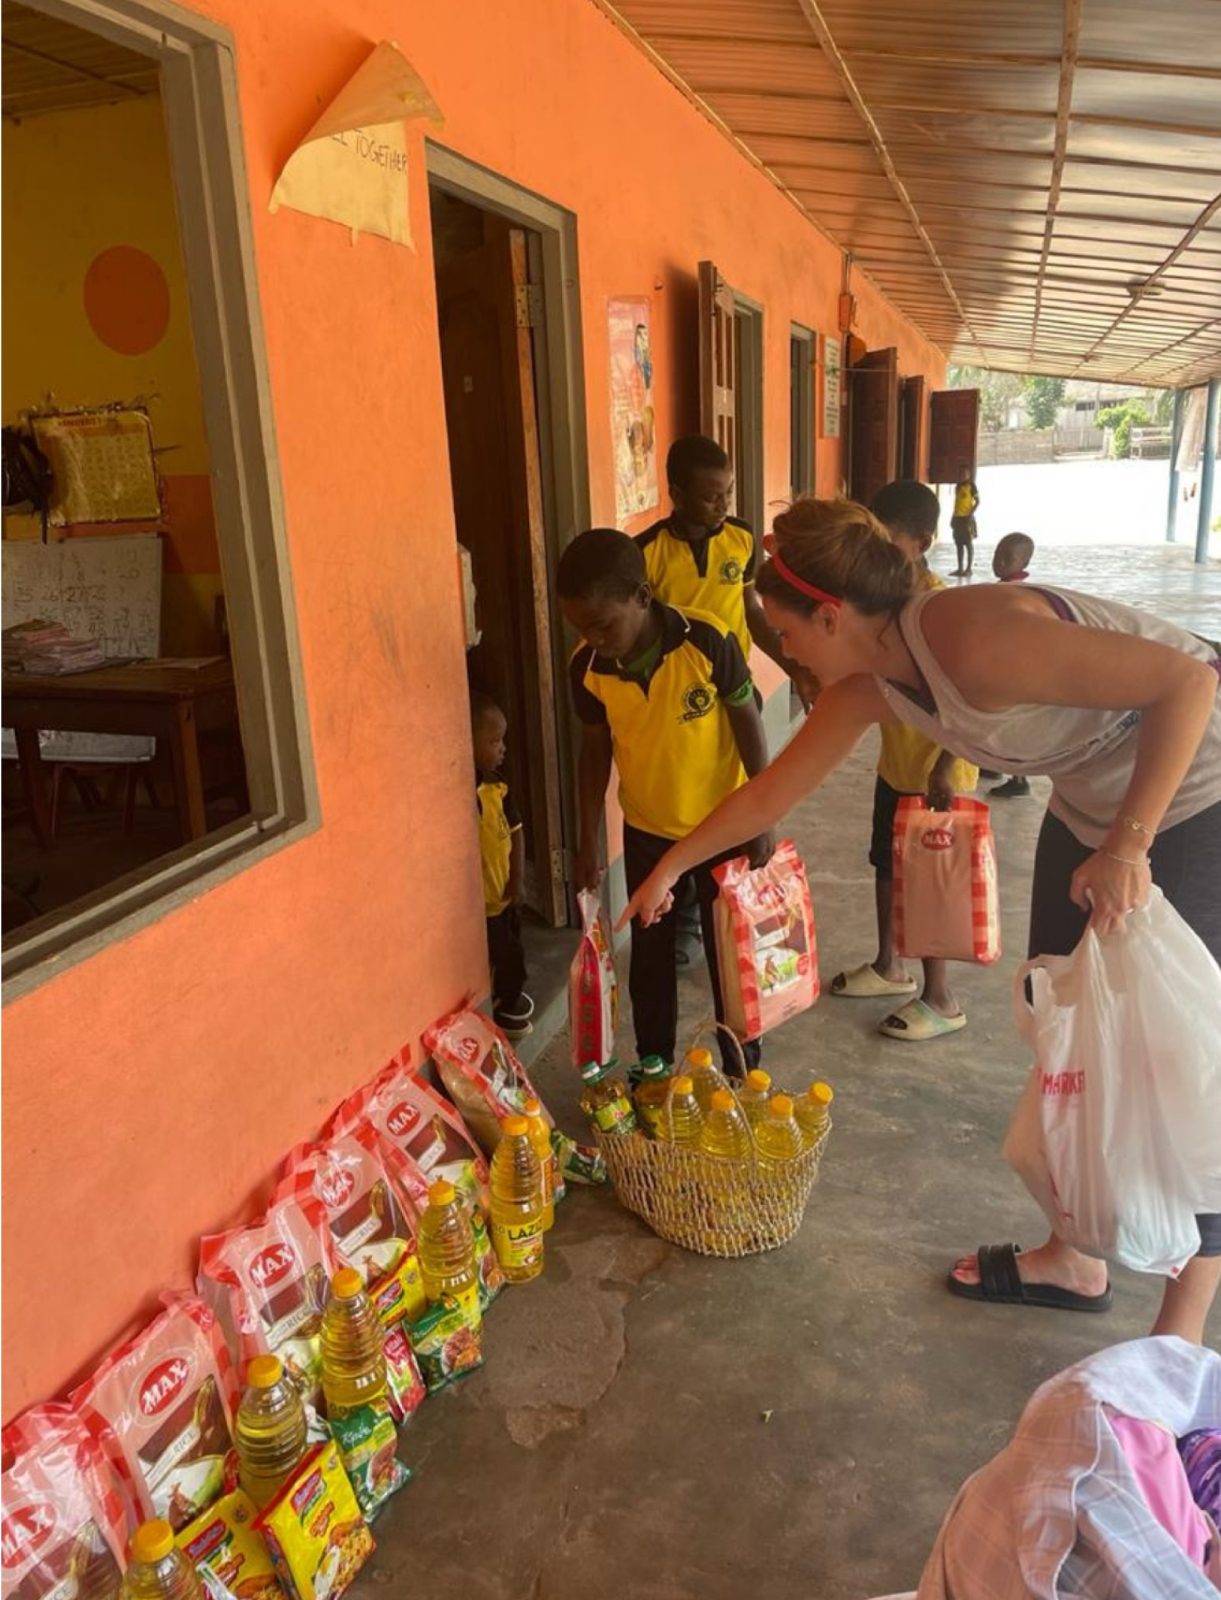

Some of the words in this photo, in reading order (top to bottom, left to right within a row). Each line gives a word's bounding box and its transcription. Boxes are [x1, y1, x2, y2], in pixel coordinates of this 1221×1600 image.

[923, 828, 953, 847] MAX
[388, 1103, 419, 1134] MAX
[251, 1246, 294, 1286] MAX
[143, 1359, 190, 1414] MAX
[2, 1505, 54, 1565] MAX
